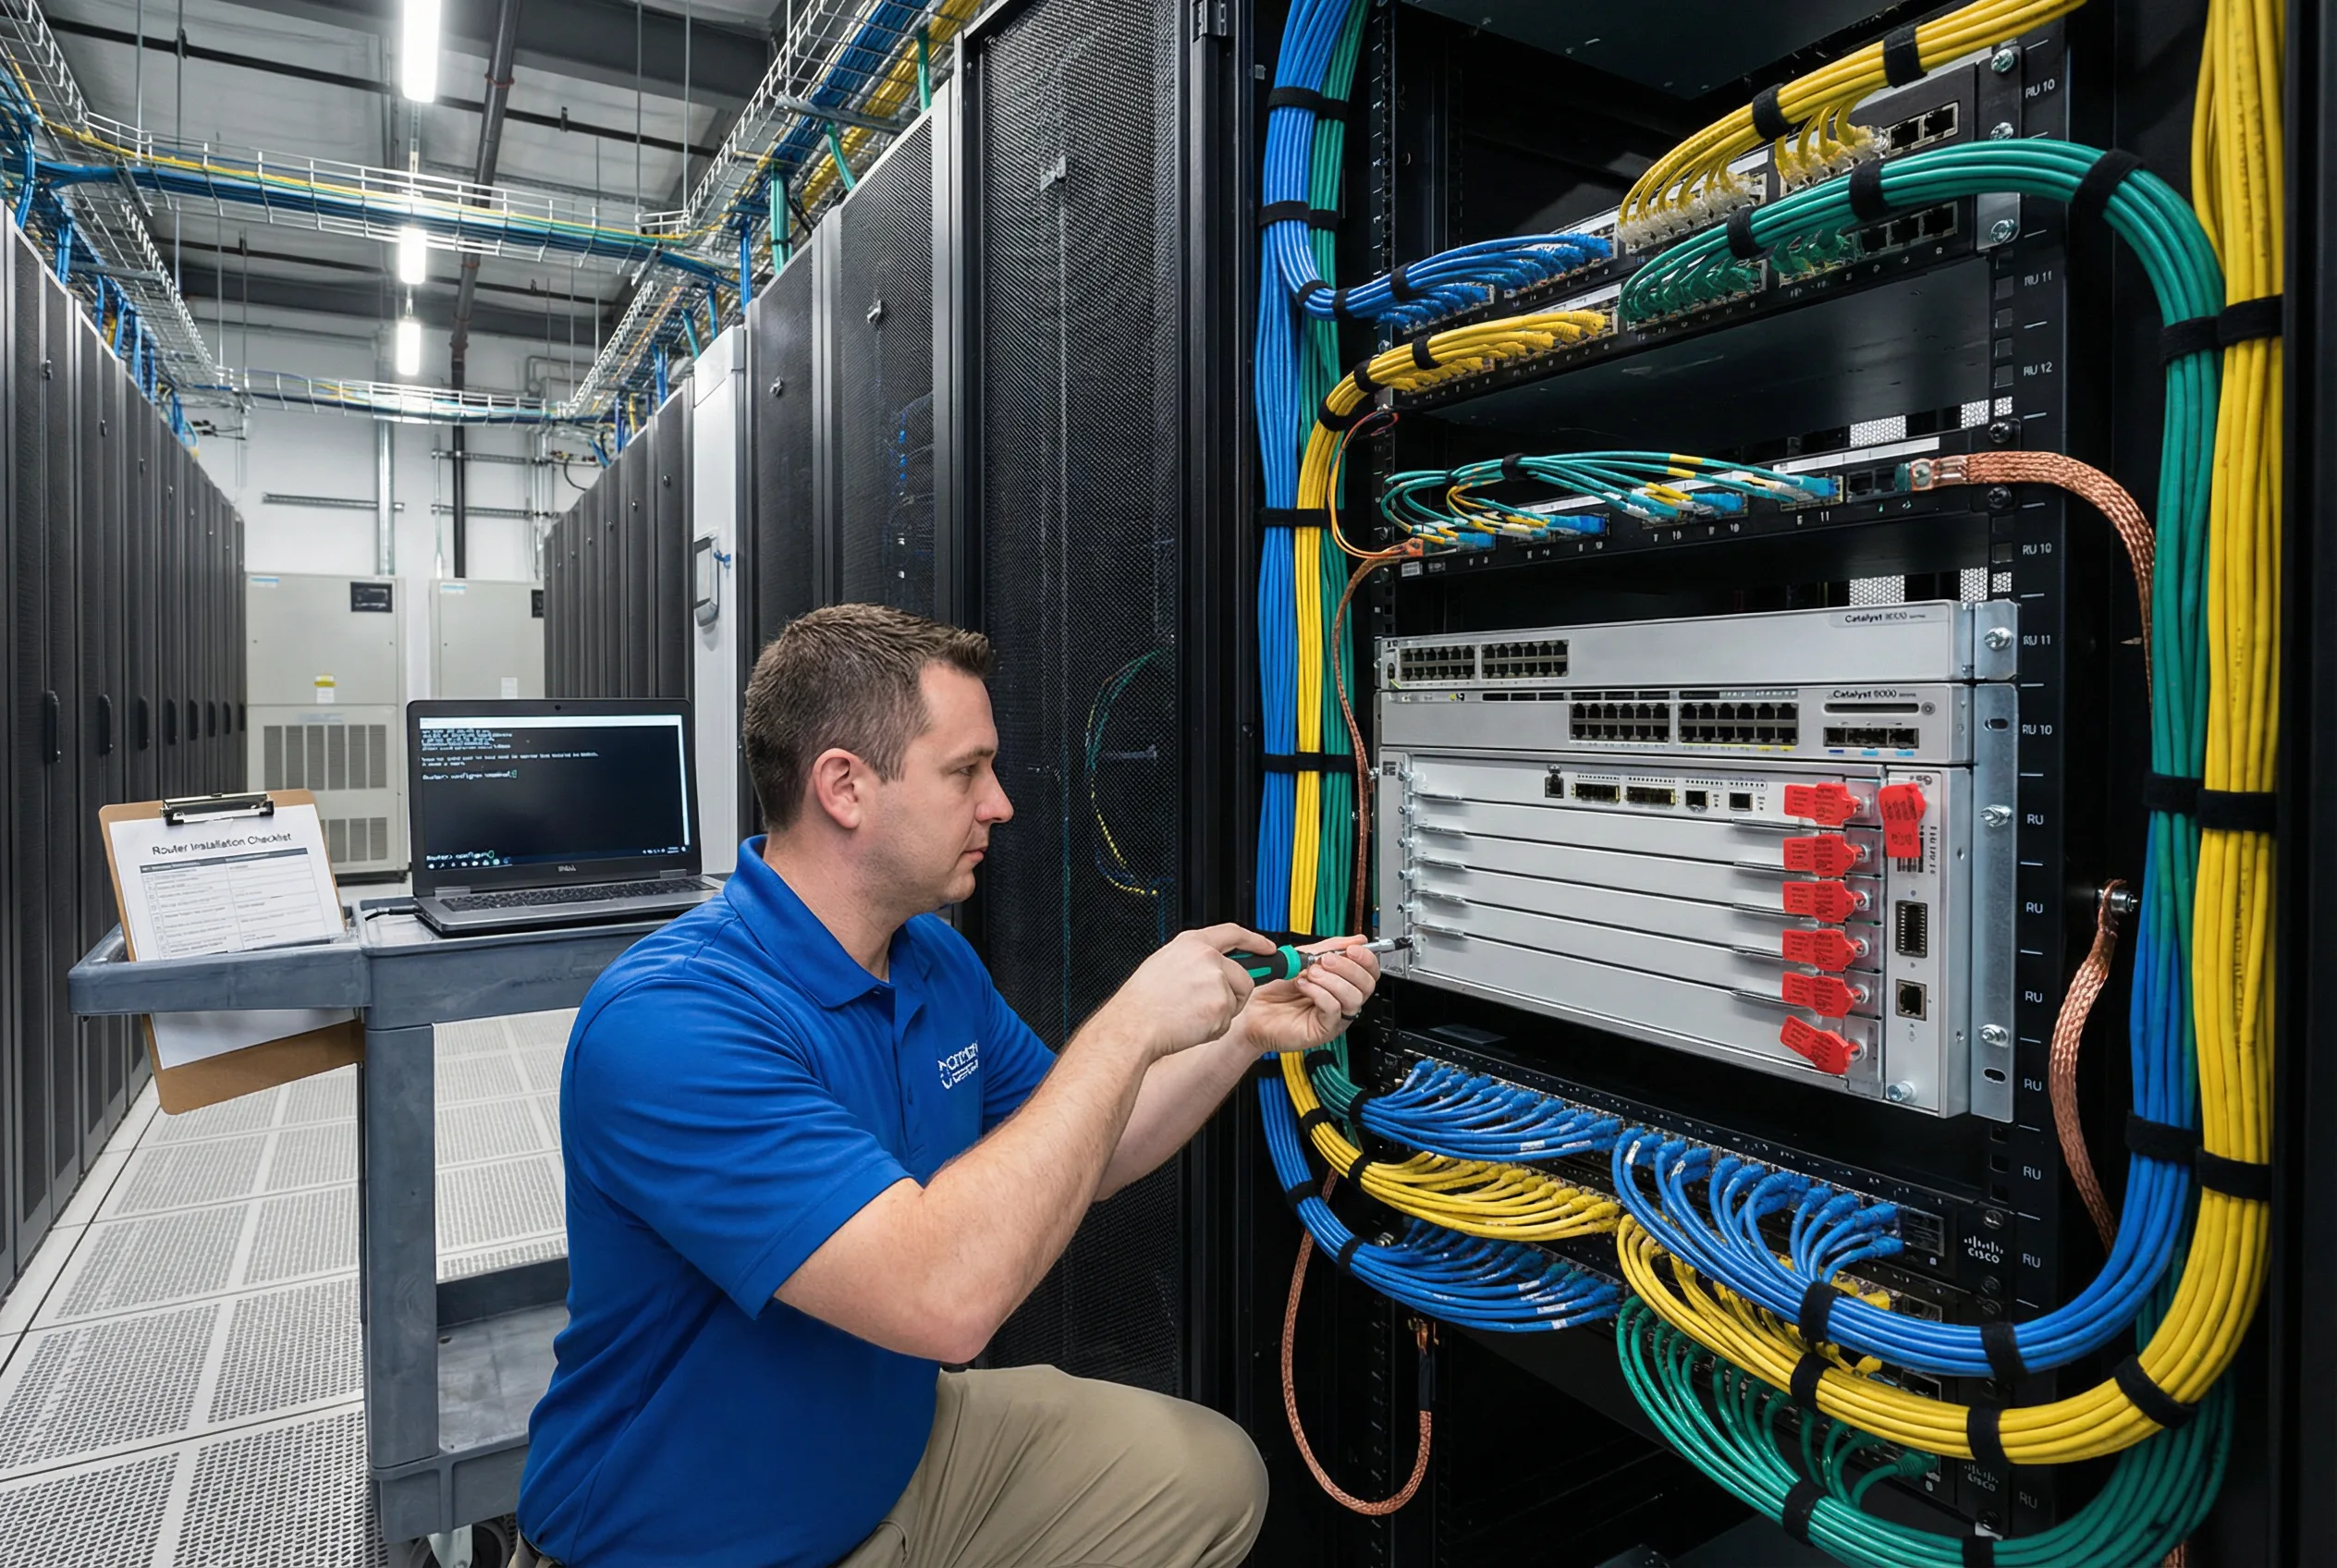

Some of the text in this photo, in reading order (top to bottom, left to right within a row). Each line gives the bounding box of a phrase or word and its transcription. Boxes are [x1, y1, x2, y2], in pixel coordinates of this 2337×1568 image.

[2025, 78, 2055, 98] RU 10
[2024, 270, 2052, 287] RU 11
[2023, 361, 2052, 376] RU 12
[2022, 542, 2052, 556] RU 10
[2023, 634, 2051, 646] RU 11
[1833, 690, 1871, 700] Catalyst
[2022, 724, 2053, 735] RU 10
[2026, 814, 2044, 826] RU
[152, 843, 189, 856] Router
[2025, 902, 2044, 913] RU
[2025, 991, 2043, 1003] RU
[2024, 1078, 2042, 1092] RU
[2023, 1165, 2041, 1181] RU
[2022, 1253, 2041, 1268] RU
[2019, 1490, 2037, 1509] RU
